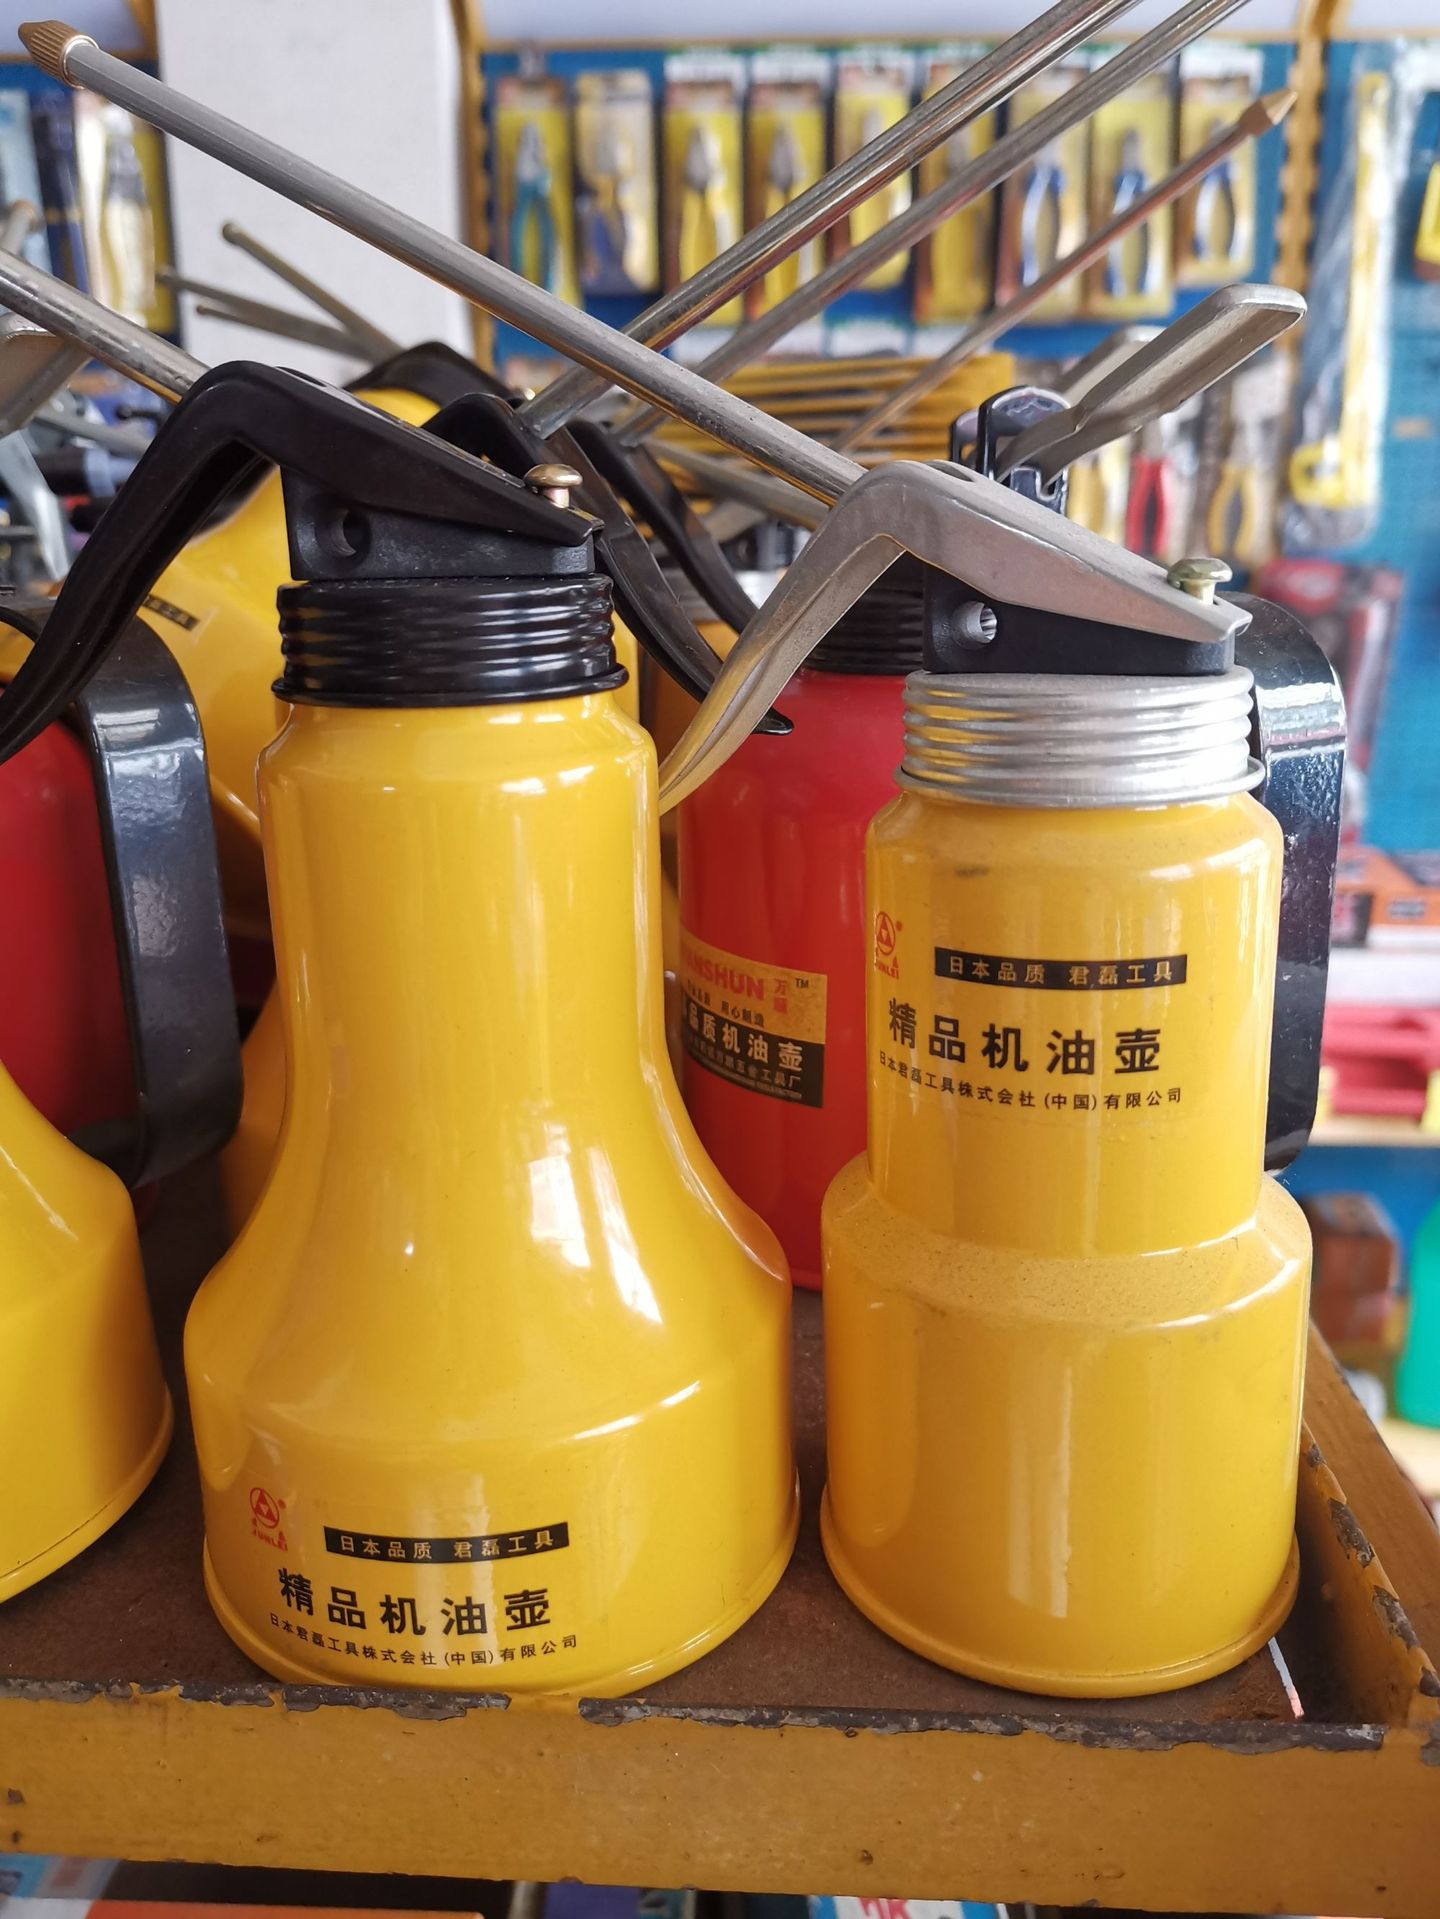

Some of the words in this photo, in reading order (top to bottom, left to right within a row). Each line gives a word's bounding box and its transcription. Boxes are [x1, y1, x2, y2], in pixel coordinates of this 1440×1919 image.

[949, 956, 1045, 985] 日本品质
[1069, 960, 1172, 985] 君磊工具
[889, 997, 1161, 1076] 精品机油壶
[340, 1535, 433, 1561] 日本品质
[454, 1530, 554, 1559] 君磊工具
[278, 1567, 551, 1637] 精品机油壶
